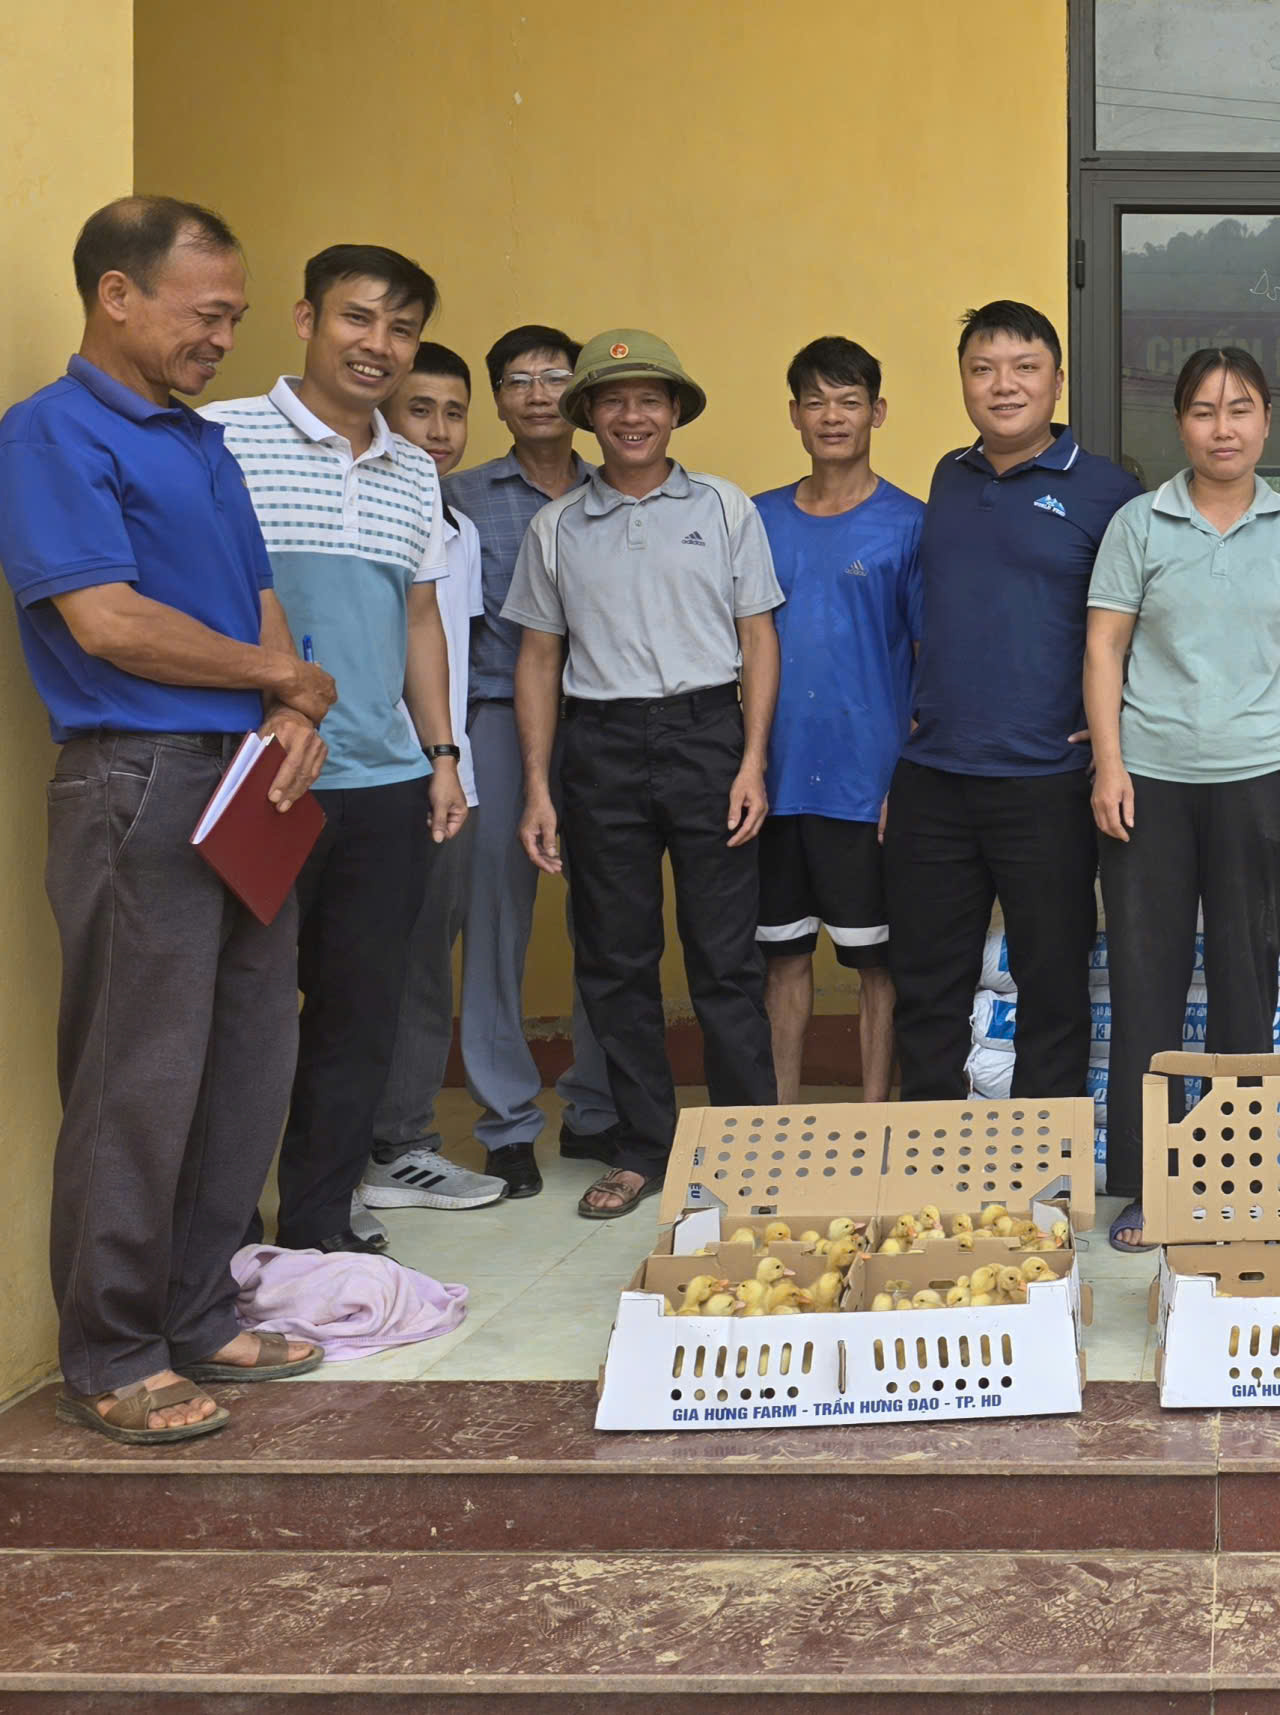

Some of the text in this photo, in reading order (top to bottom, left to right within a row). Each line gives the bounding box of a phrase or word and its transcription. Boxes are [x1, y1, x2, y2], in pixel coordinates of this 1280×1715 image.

[681, 539, 706, 547] adidas
[1232, 1384, 1257, 1397] GIA
[672, 1408, 699, 1421] GIA
[704, 1407, 748, 1421] HƯNG
[753, 1404, 797, 1419] FARM
[860, 1398, 903, 1413] HƯNG
[908, 1397, 939, 1414] ĐẠO
[955, 1395, 976, 1409] TP.
[981, 1394, 1002, 1408] HD
